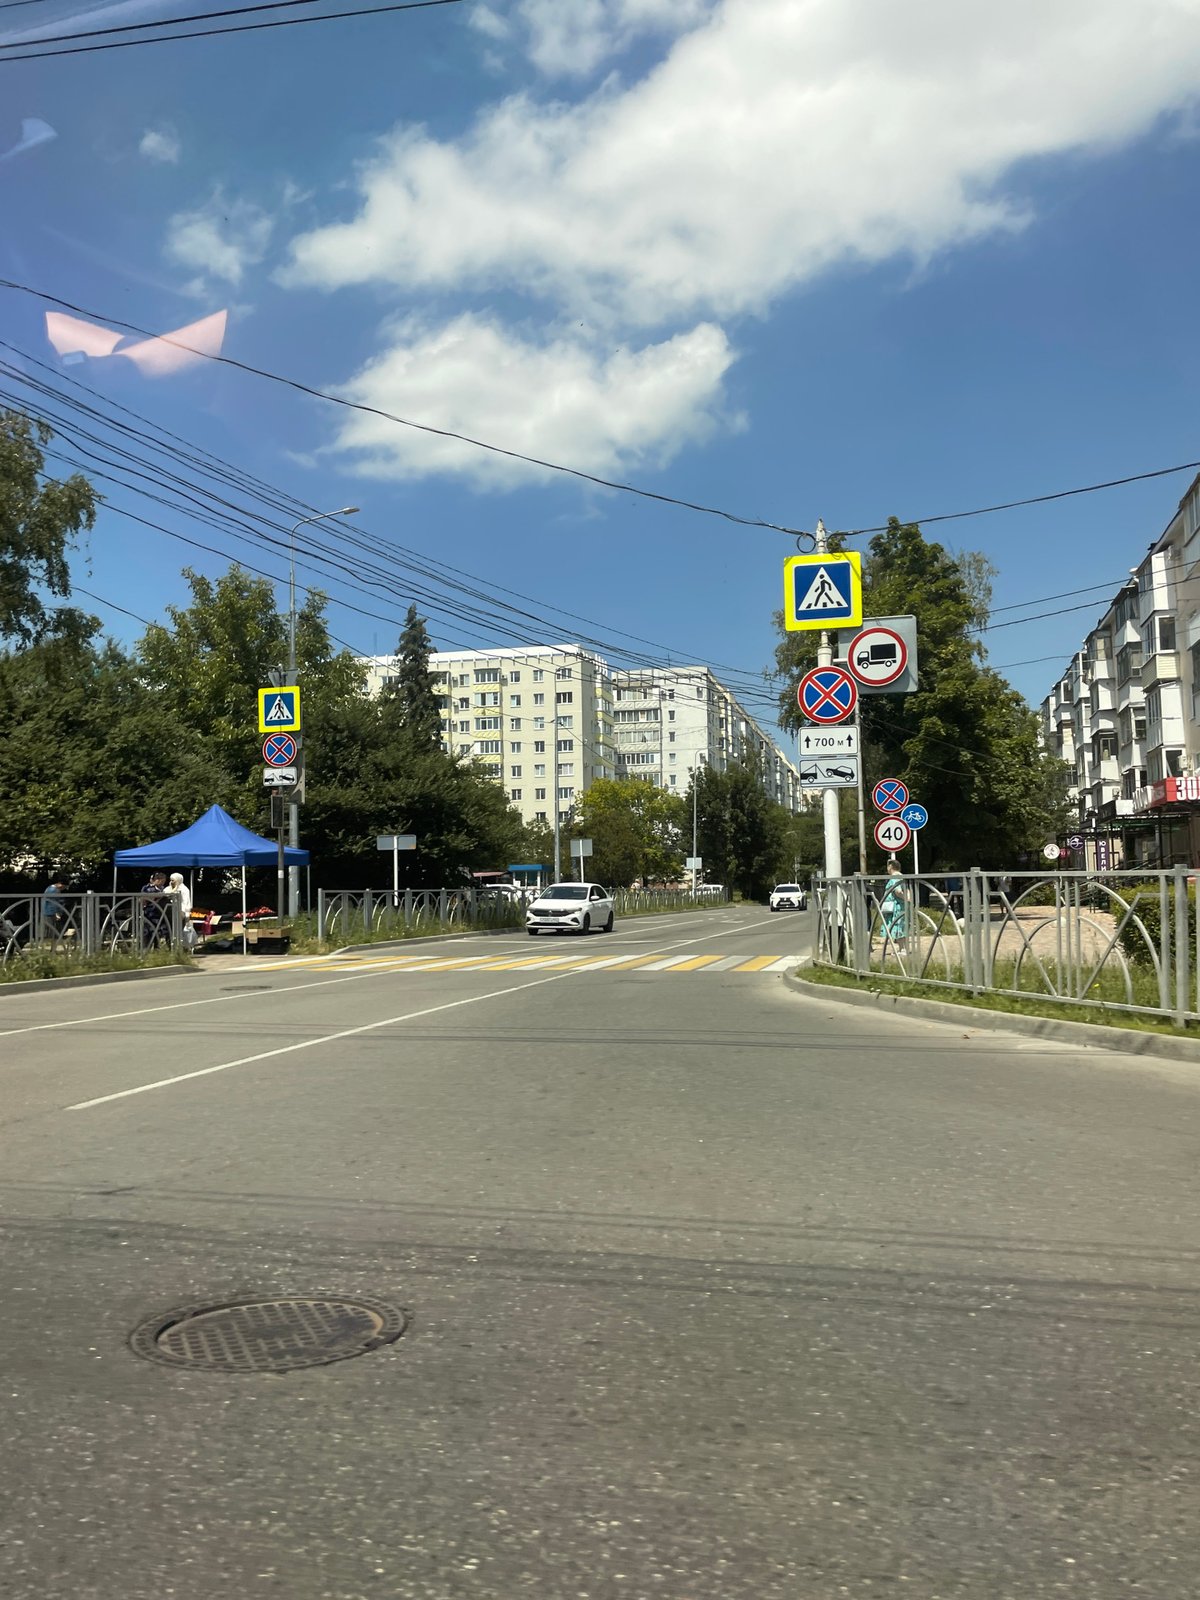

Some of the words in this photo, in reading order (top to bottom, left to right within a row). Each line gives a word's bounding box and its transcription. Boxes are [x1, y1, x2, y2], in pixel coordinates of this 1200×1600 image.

[814, 738, 835, 747] 700
[1175, 776, 1200, 801] ЗО
[881, 826, 903, 841] 40
